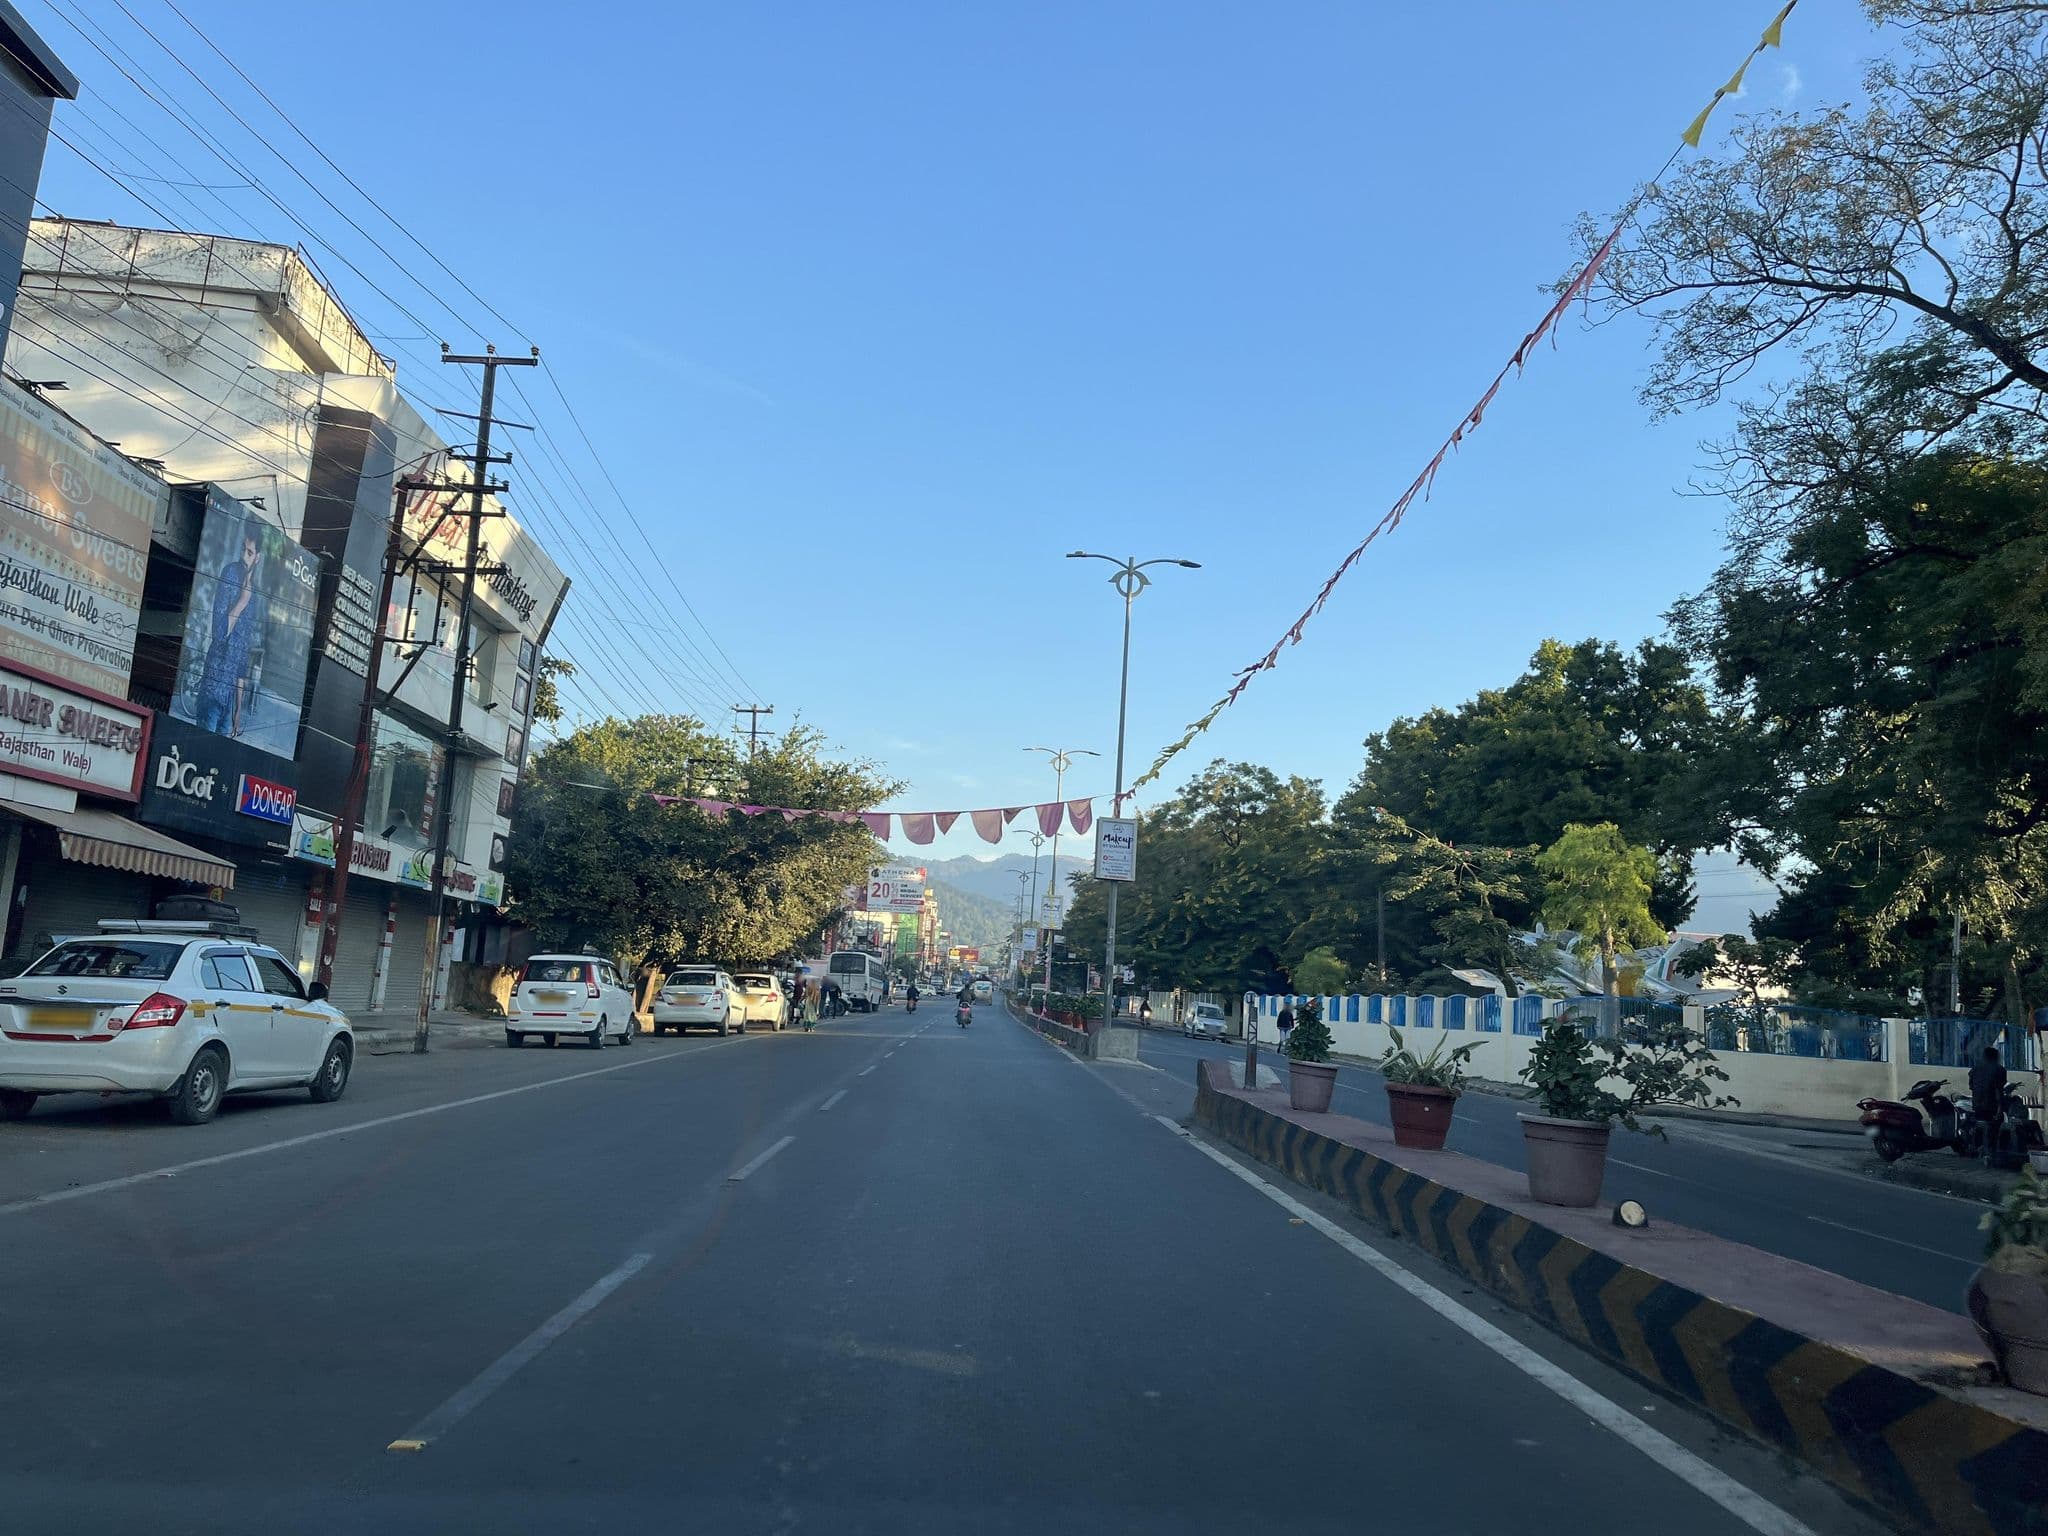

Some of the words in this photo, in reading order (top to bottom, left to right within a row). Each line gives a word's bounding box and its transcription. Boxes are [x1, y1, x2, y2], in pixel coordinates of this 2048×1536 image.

[61, 467, 82, 498] BS
[71, 511, 144, 582] Sweets
[64, 584, 99, 624] Wale
[21, 606, 46, 634] Desi
[77, 633, 131, 672] Preparation
[57, 704, 141, 753] SWEETS
[63, 749, 92, 775] Wale)
[252, 783, 294, 819] DONEAR
[1103, 833, 1133, 849] Makeup
